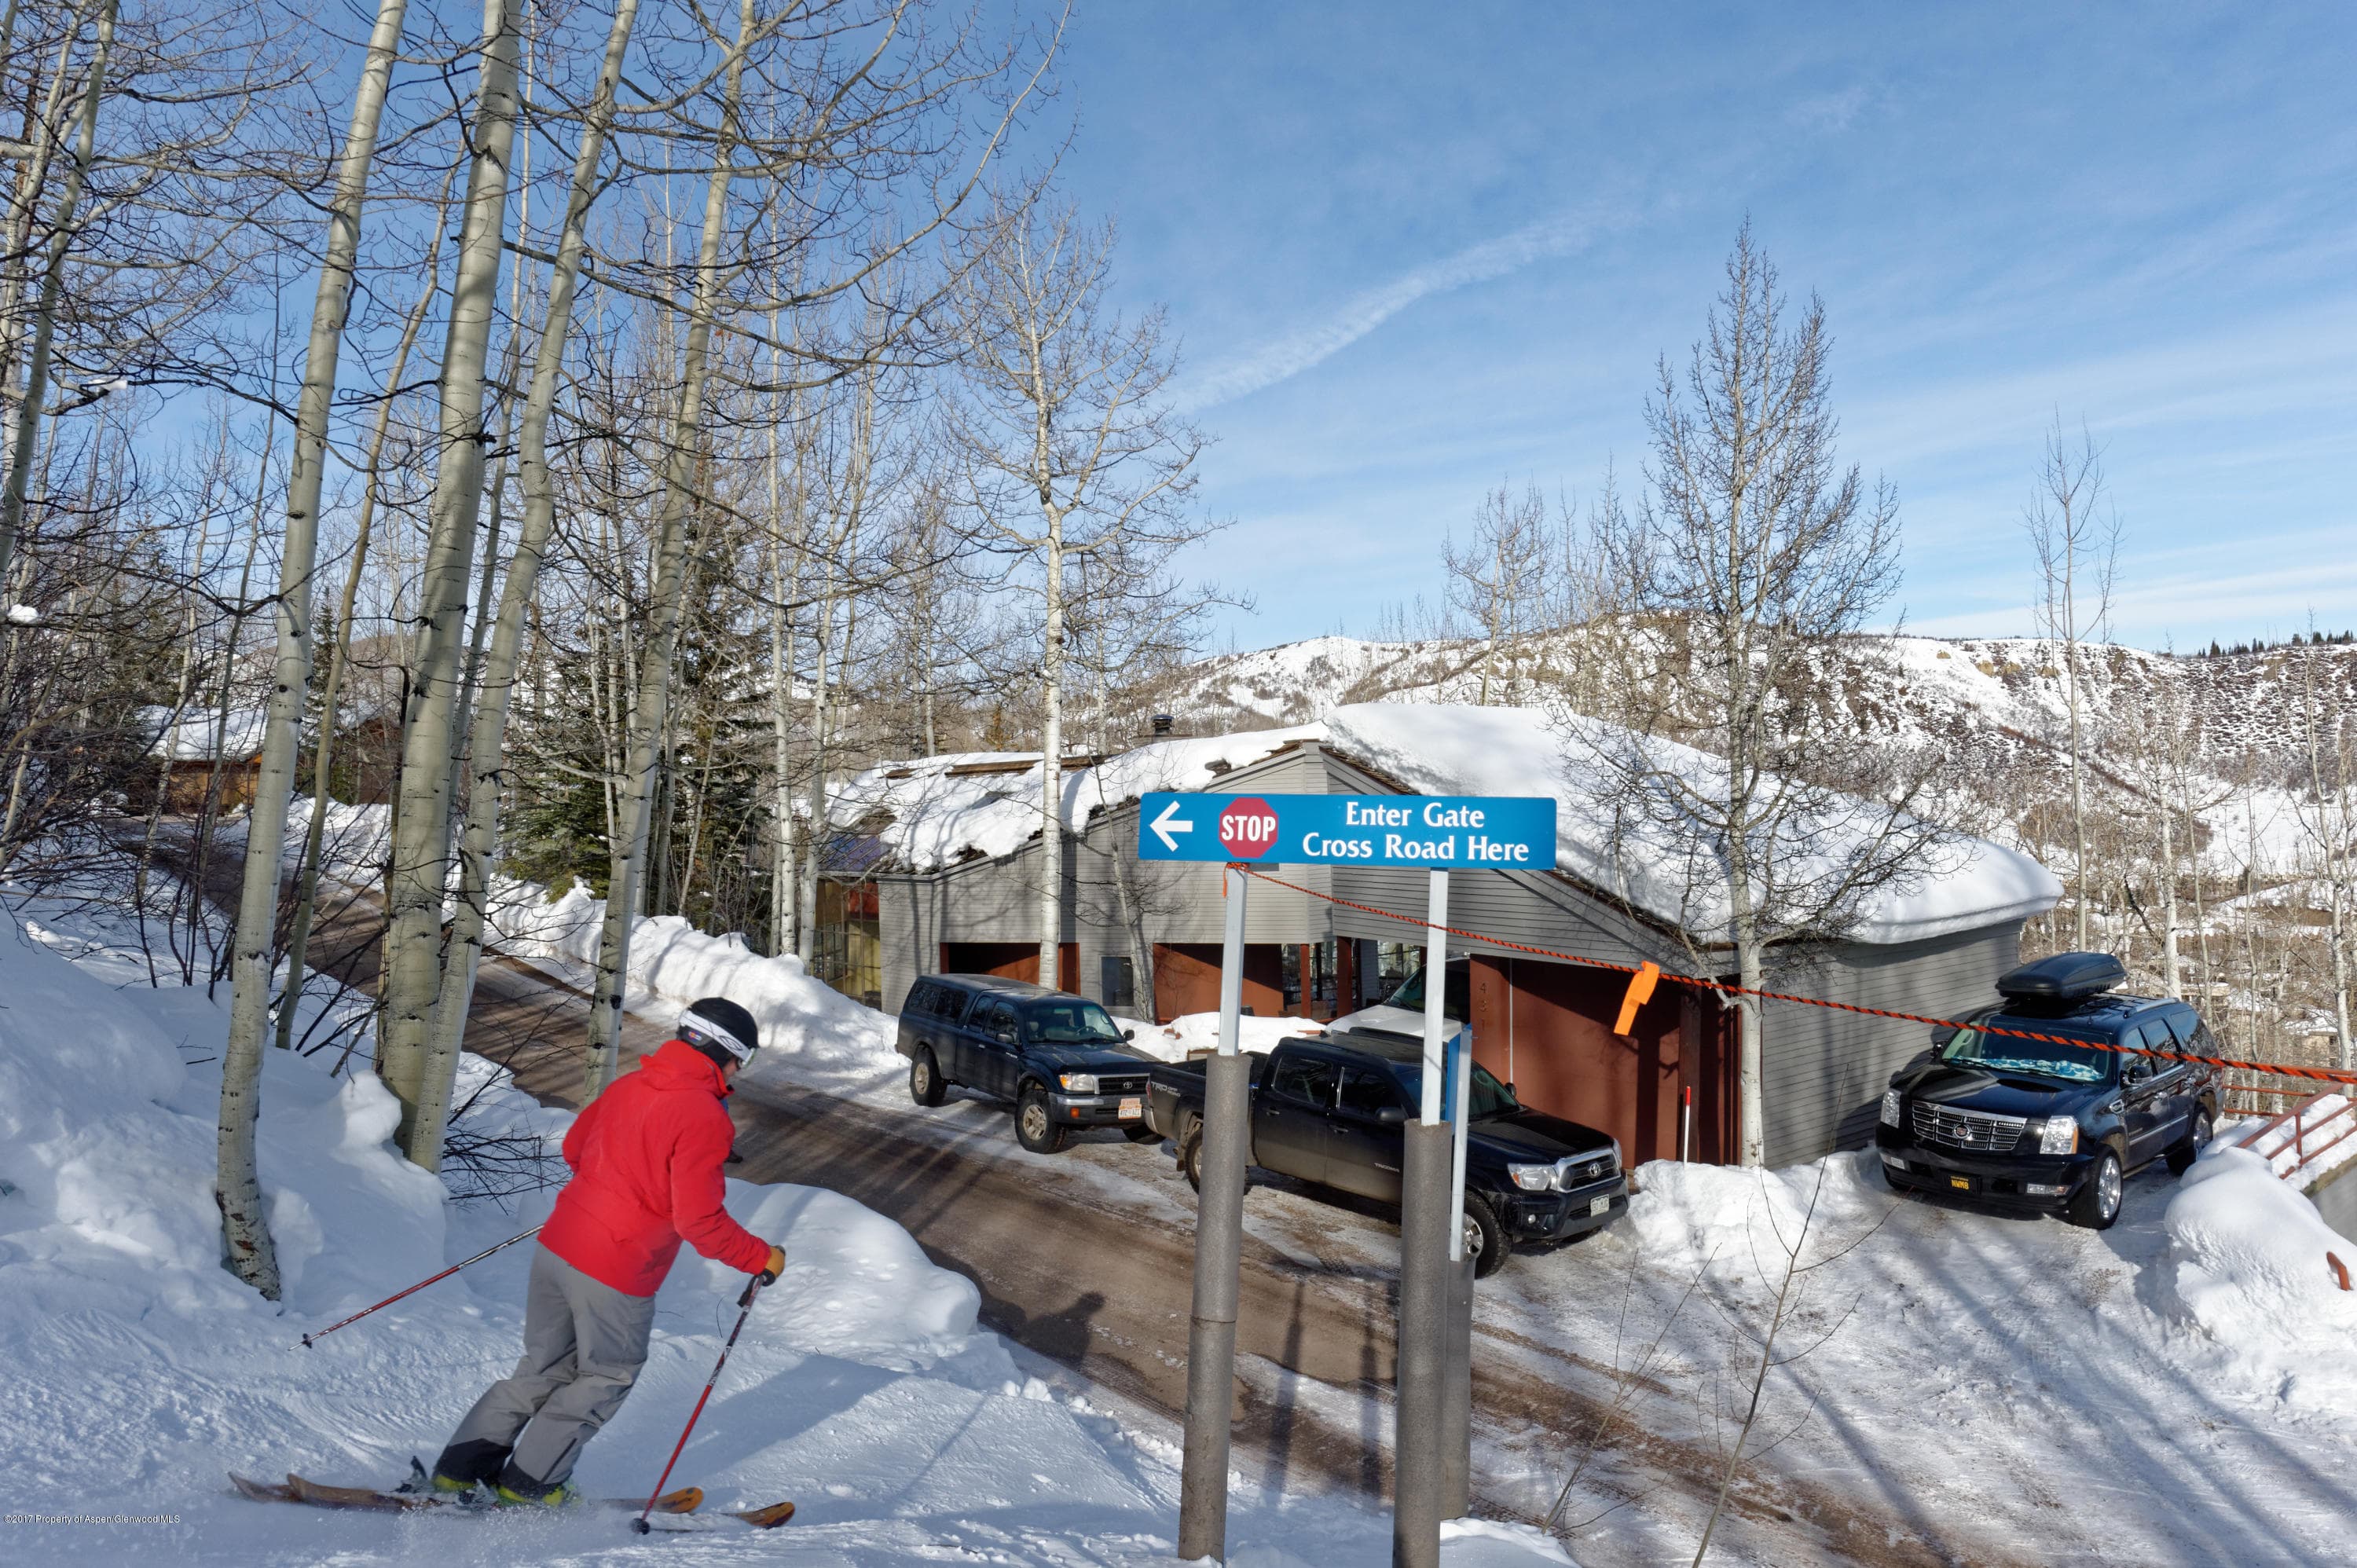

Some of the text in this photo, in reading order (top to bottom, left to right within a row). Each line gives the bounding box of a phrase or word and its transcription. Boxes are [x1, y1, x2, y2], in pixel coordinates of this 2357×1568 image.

[1346, 801, 1484, 828] Enter Gate
[1221, 815, 1277, 842] STOP
[1303, 832, 1529, 862] Cross Road Here
